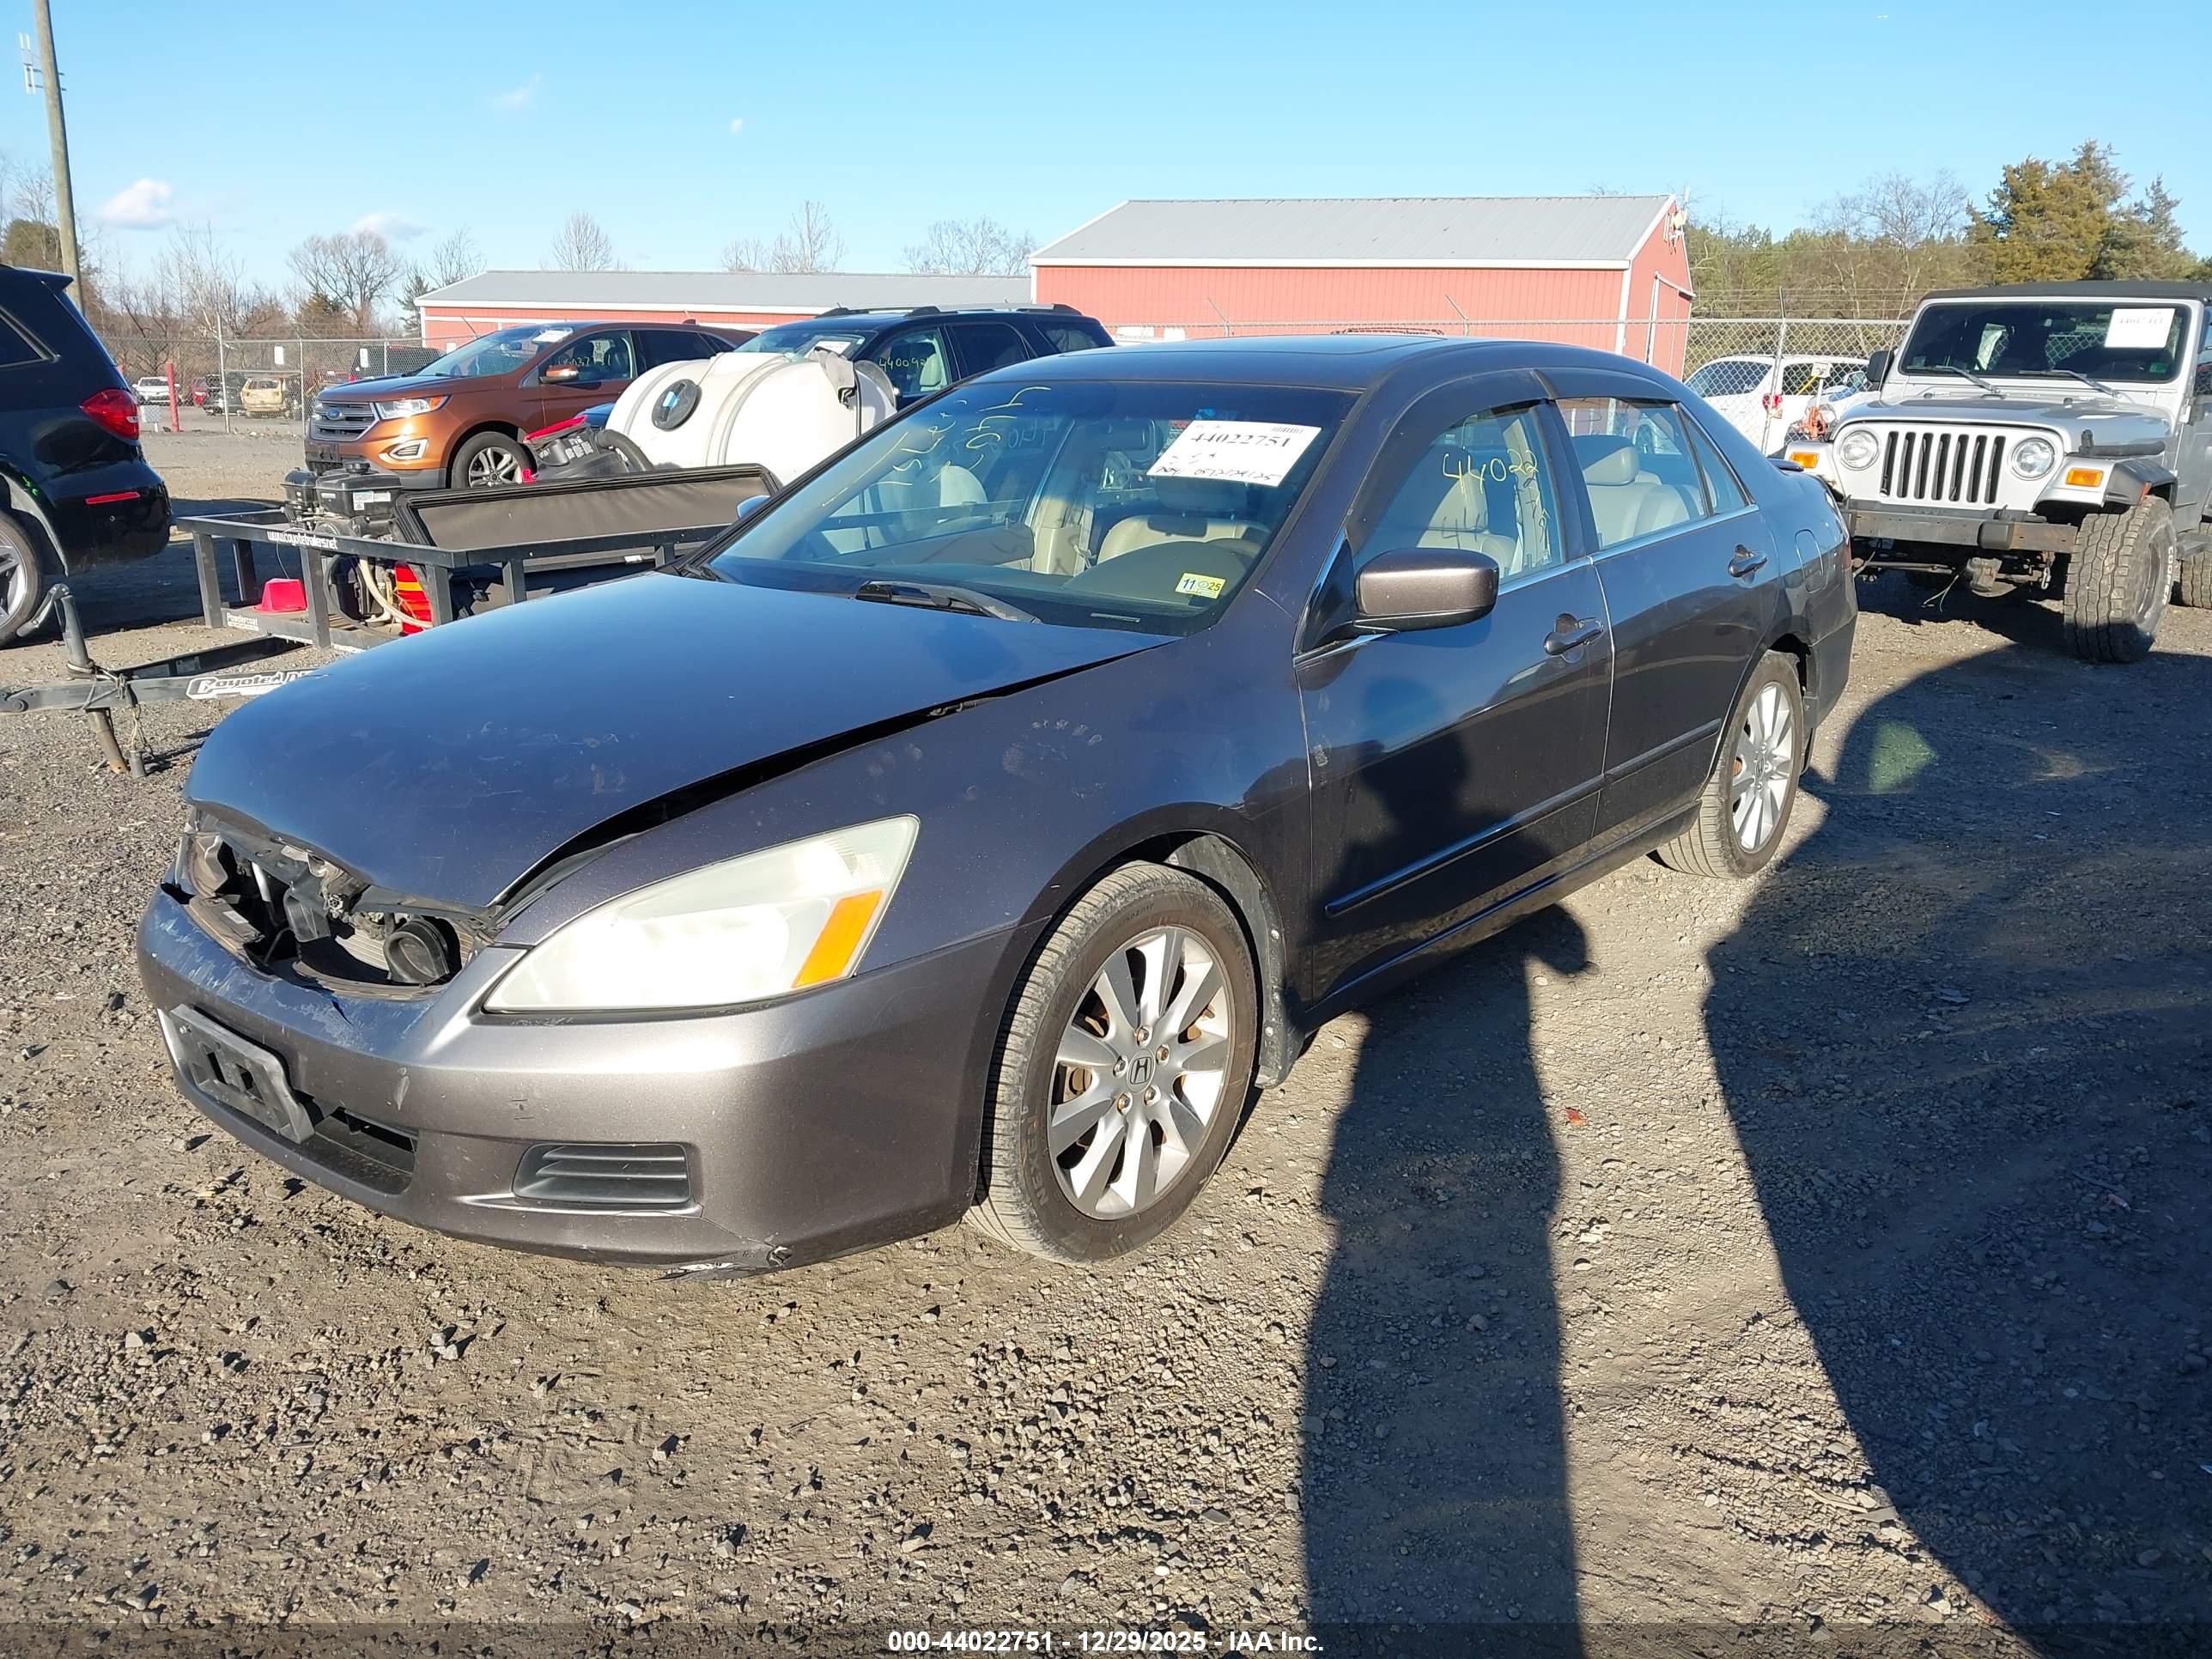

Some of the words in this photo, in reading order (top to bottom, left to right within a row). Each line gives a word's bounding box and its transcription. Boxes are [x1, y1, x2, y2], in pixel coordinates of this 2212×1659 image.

[1191, 432, 1291, 447] 44022751
[1182, 578, 1196, 590] 11
[1207, 581, 1221, 591] 25
